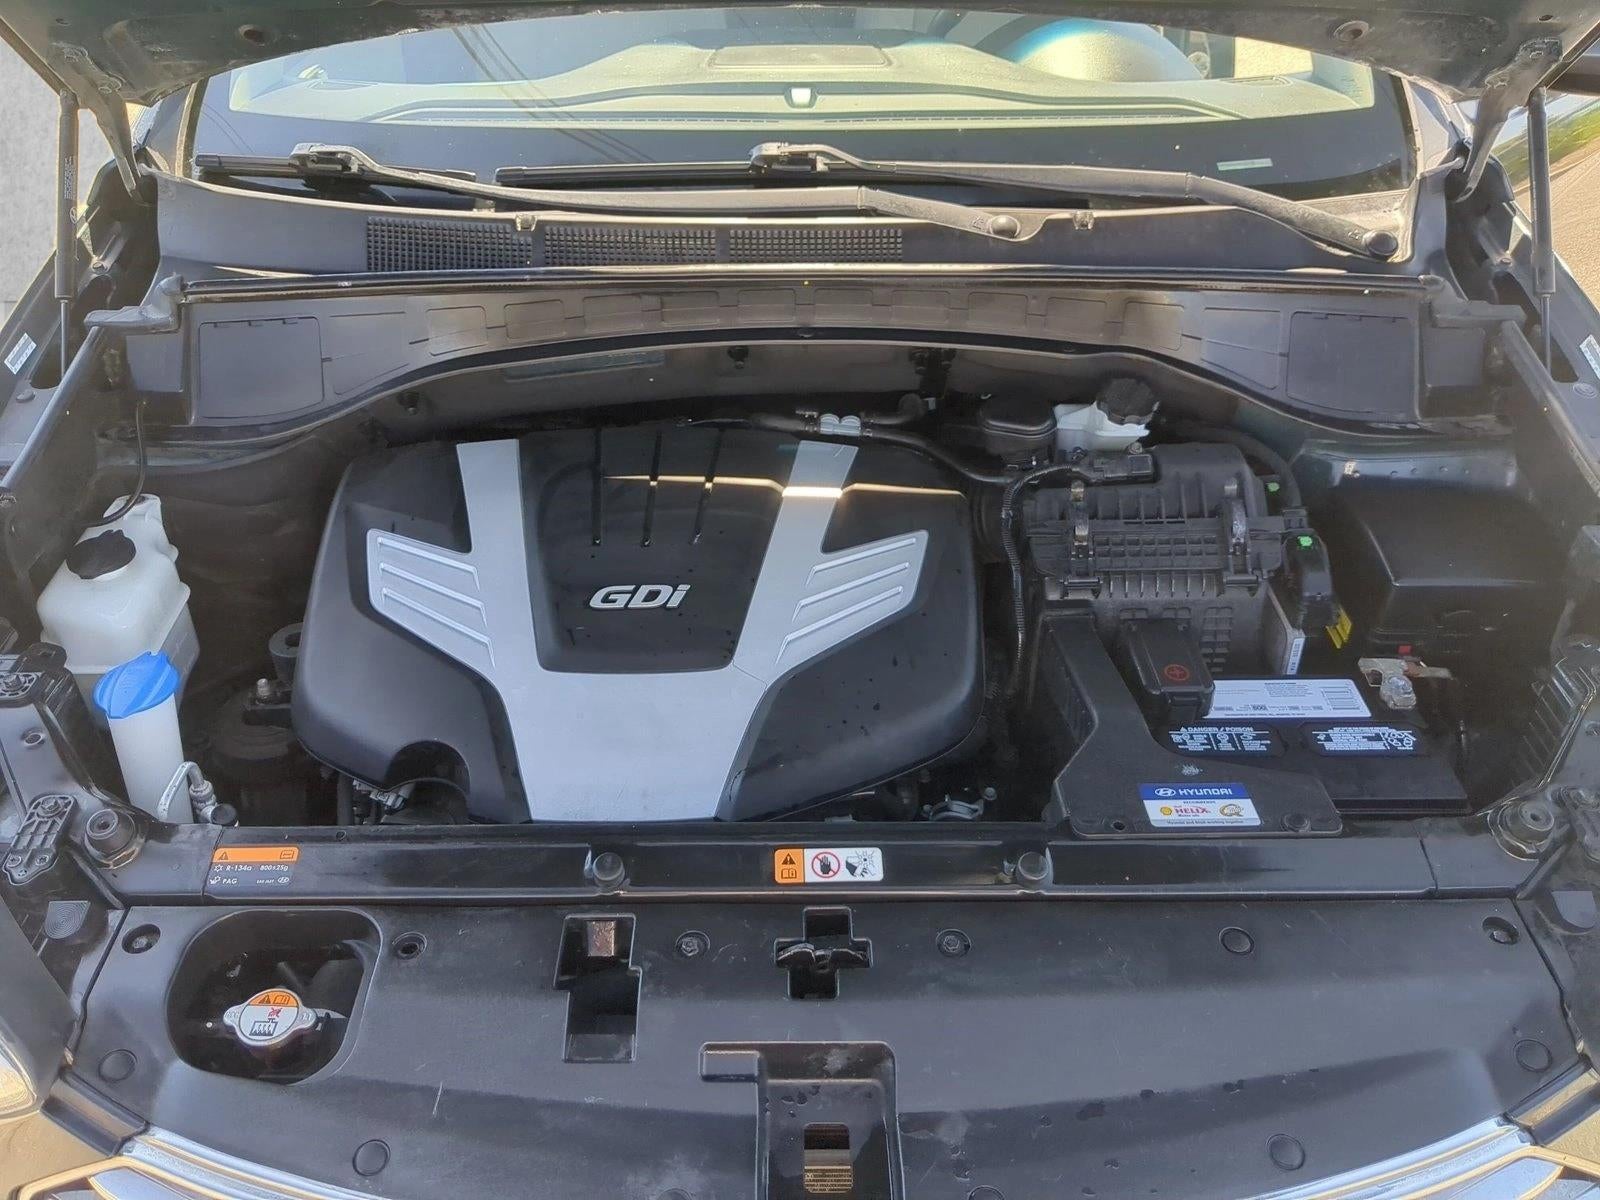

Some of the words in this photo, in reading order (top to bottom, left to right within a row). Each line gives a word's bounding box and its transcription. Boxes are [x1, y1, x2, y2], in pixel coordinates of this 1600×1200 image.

[589, 584, 691, 609] GDi
[1179, 788, 1233, 796] HYUNDAI
[1174, 806, 1209, 814] HELIX
[225, 864, 252, 872] R-134a
